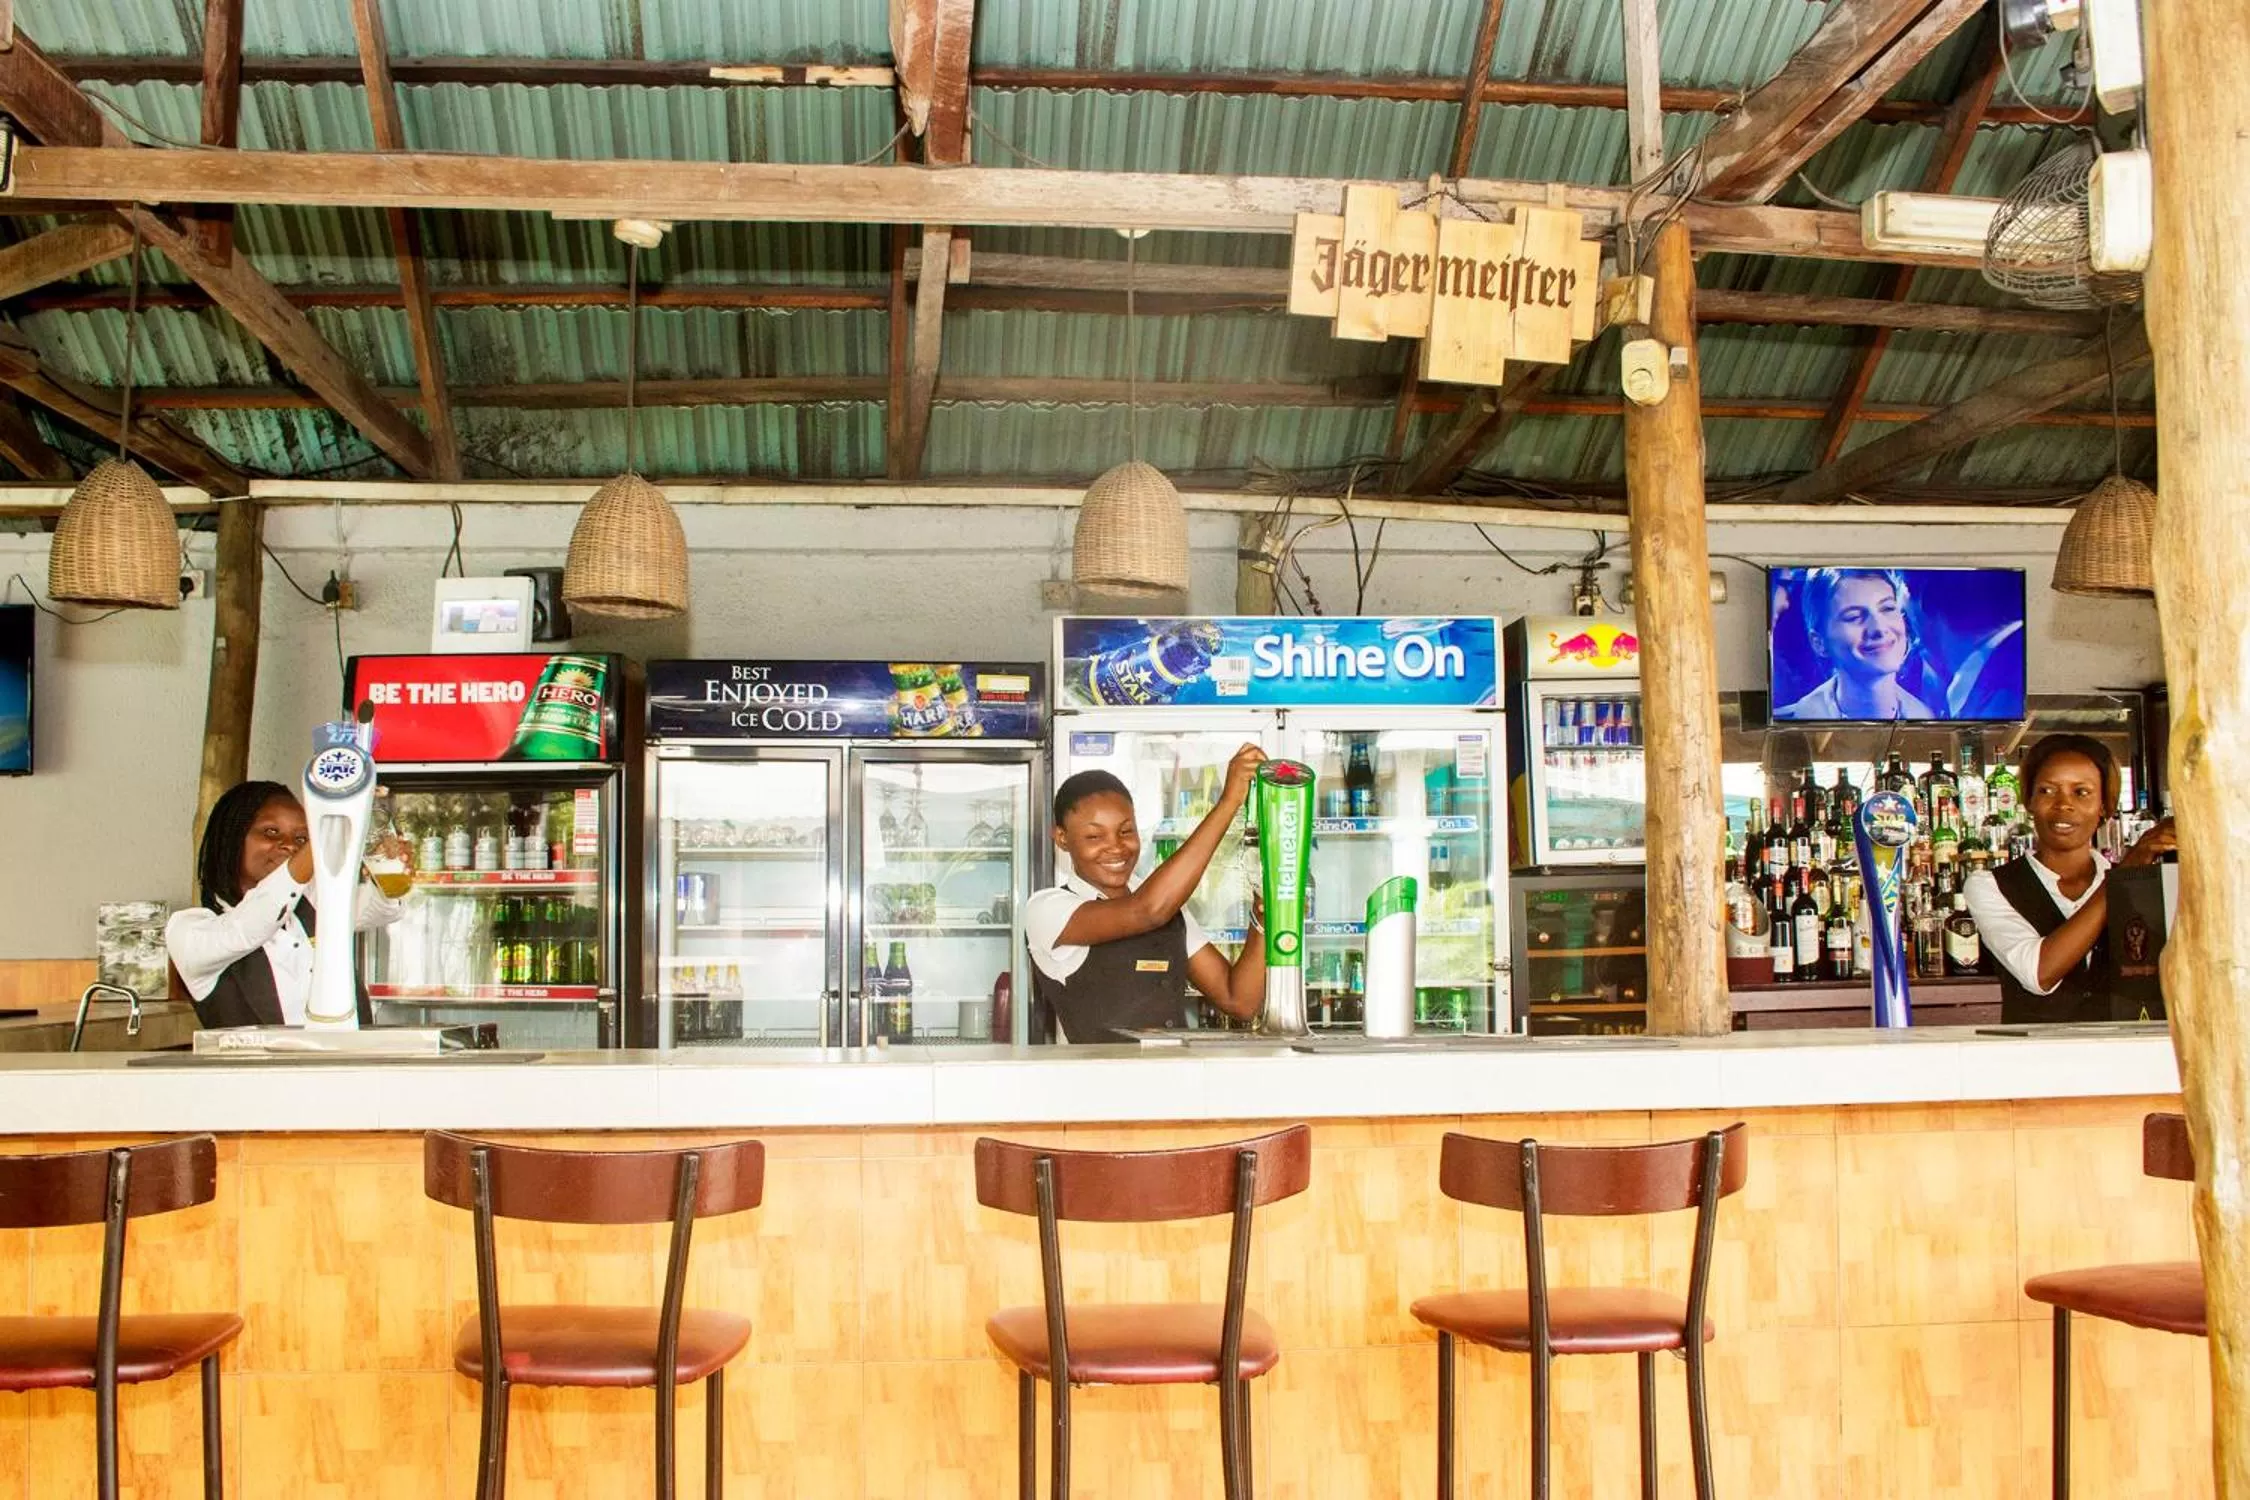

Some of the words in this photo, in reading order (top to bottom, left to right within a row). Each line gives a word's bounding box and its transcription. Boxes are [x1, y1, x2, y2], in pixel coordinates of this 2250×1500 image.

[1253, 633, 1386, 679] Shine
[1393, 634, 1465, 678] On
[731, 665, 772, 681] BEST
[369, 683, 401, 705] BE
[406, 683, 457, 705] THE
[461, 681, 526, 705] HERO
[541, 686, 597, 706] HERO
[704, 680, 829, 710] ENJOYED
[731, 712, 759, 728] ICE
[761, 707, 842, 732] COLD
[1341, 819, 1357, 831] On
[1439, 819, 1455, 830] On
[1872, 811, 1906, 828] STAR
[1277, 799, 1298, 901] Heineken
[1315, 923, 1342, 934] Shine
[1342, 923, 1359, 934] On
